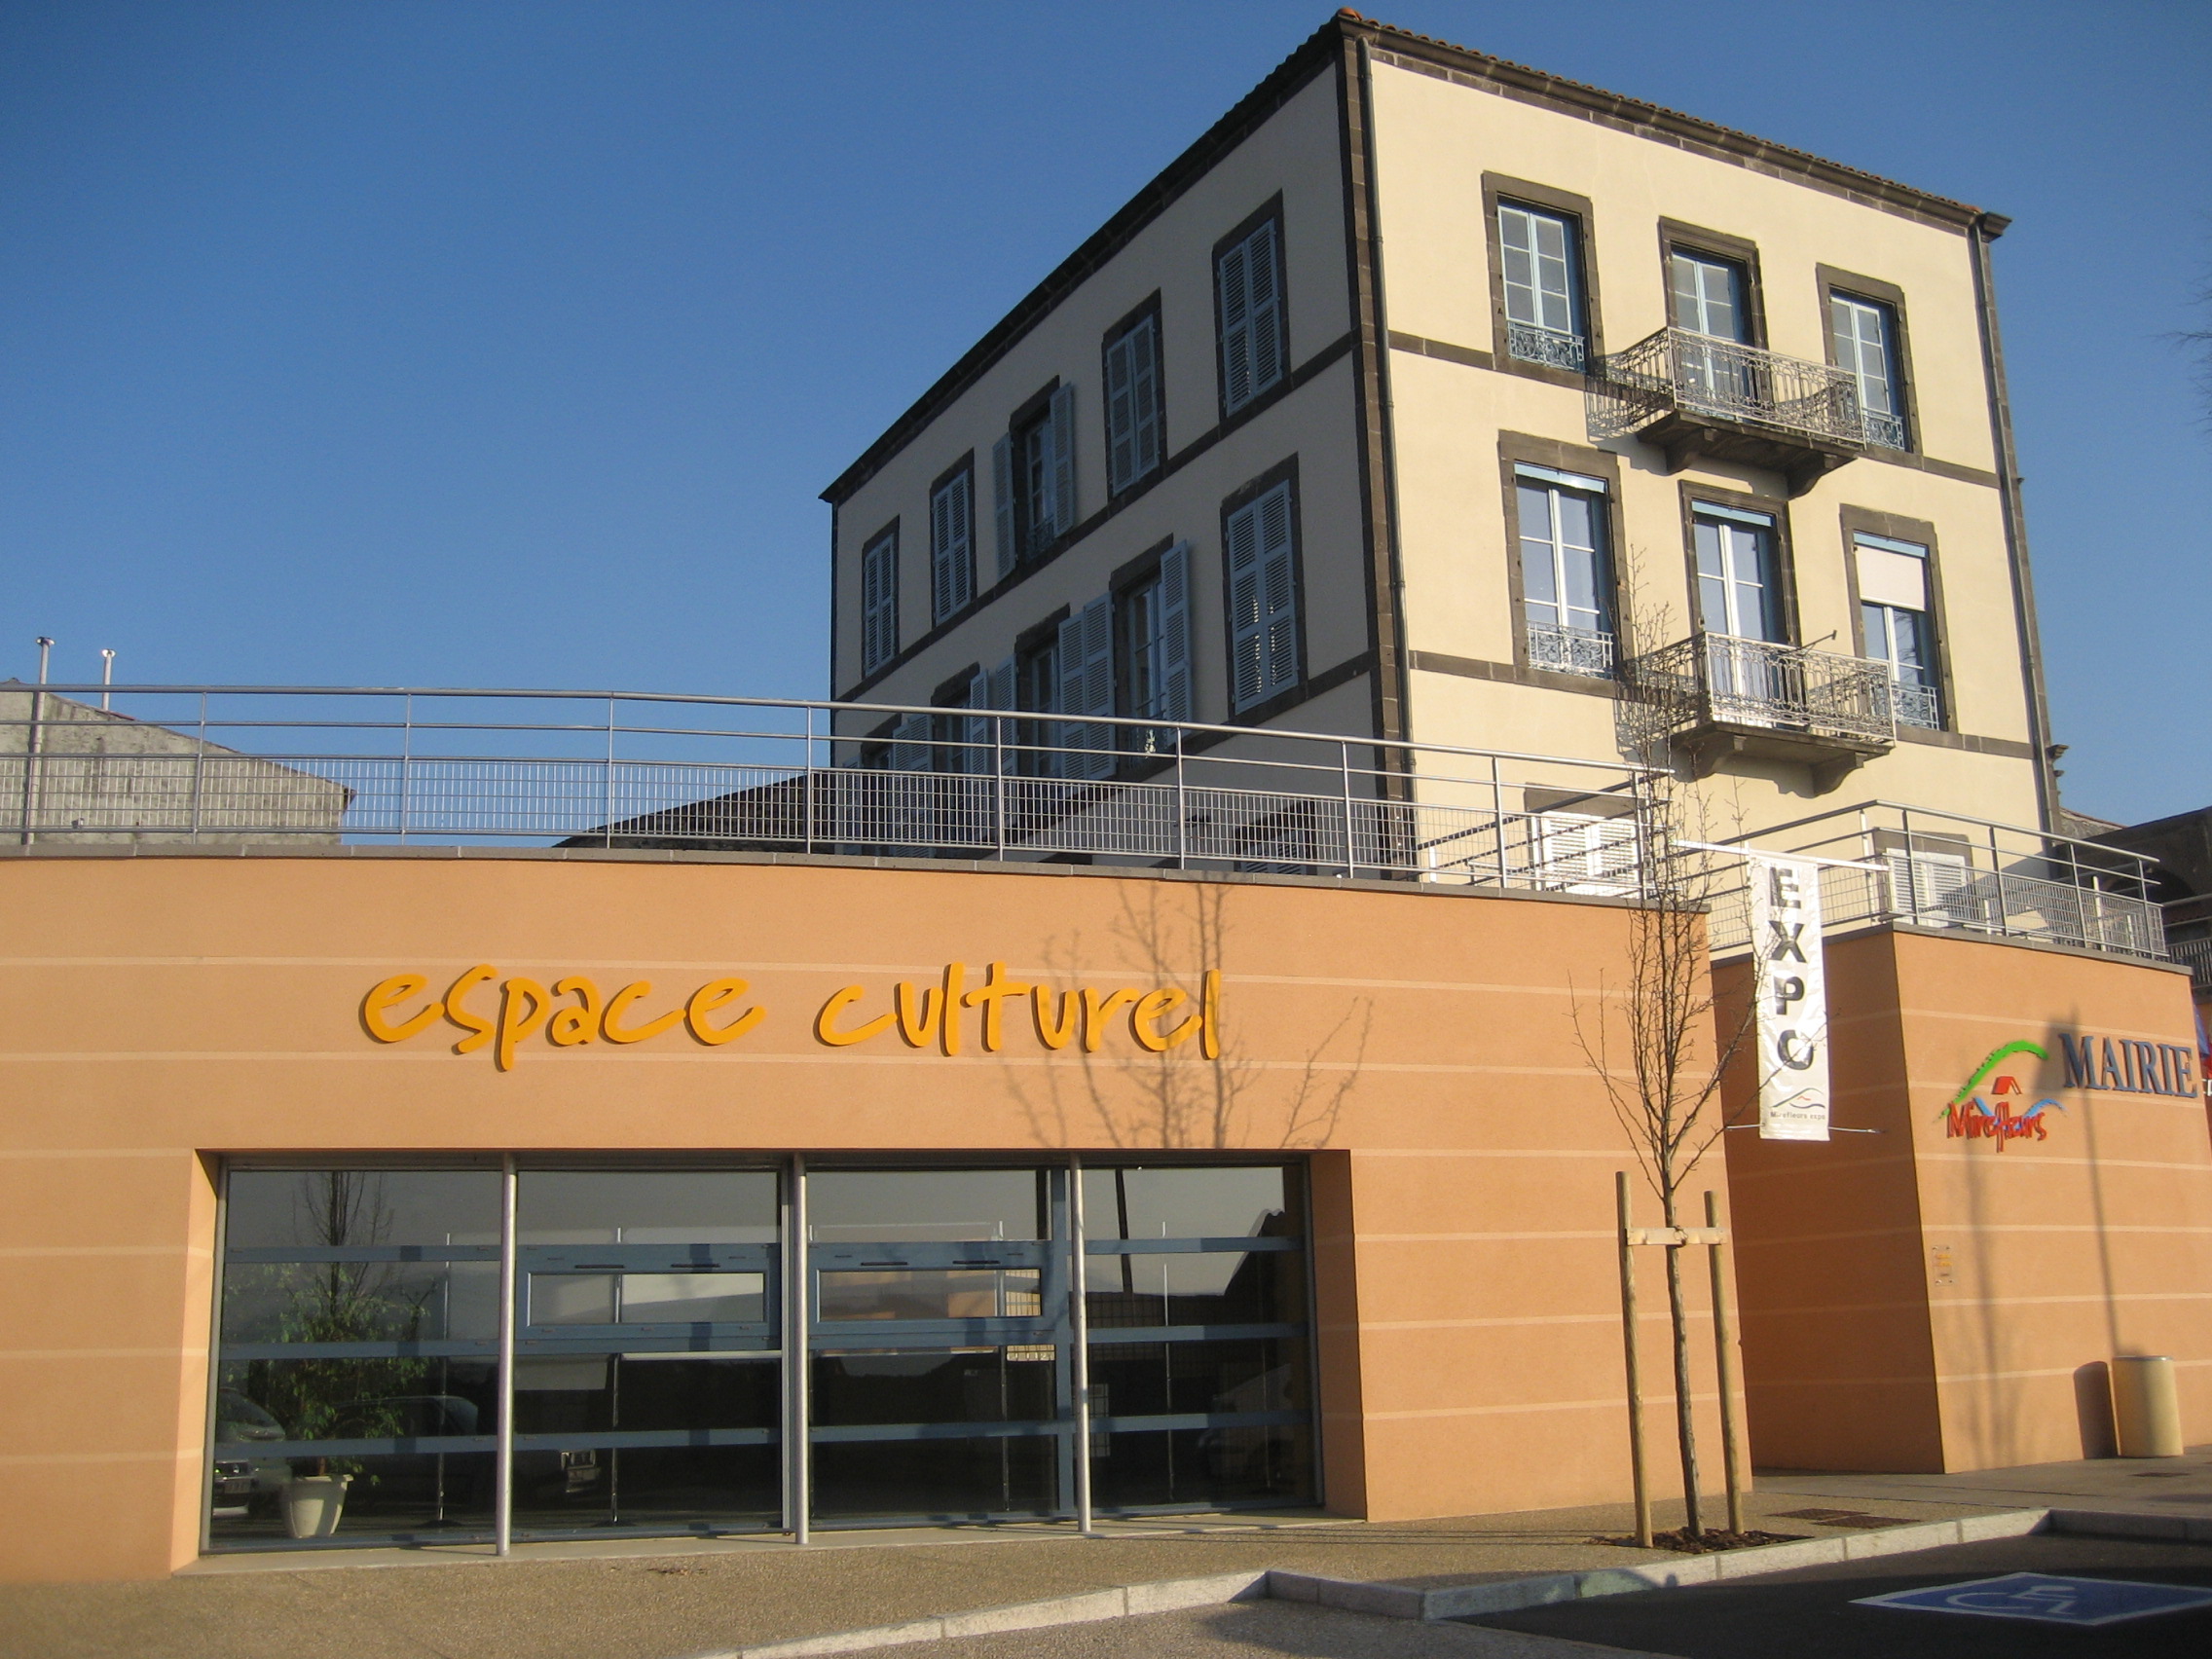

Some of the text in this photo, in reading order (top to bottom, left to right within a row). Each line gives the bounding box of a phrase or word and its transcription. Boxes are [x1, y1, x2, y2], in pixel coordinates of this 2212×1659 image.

[360, 962, 1220, 1071] espace culturel
[1768, 866, 1814, 1071] EXPO
[2057, 1033, 2197, 1098] MAIRIE
